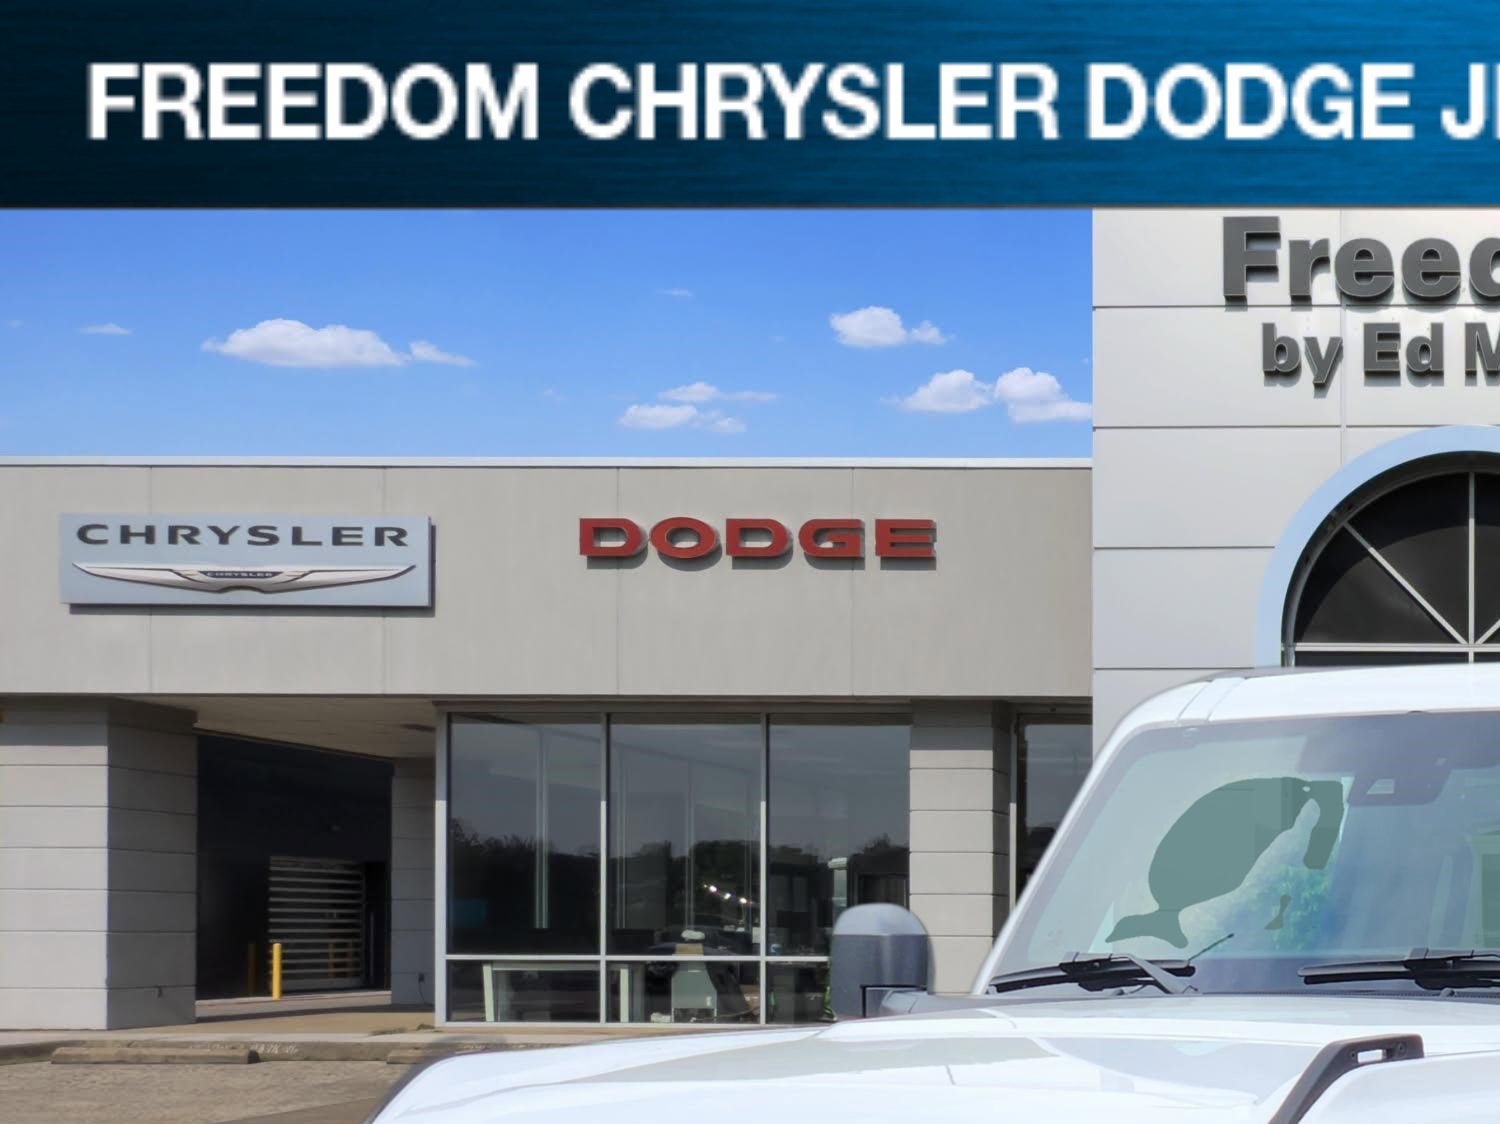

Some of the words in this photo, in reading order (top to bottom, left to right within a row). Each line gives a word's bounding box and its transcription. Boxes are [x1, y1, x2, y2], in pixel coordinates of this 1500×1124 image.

[1262, 322, 1343, 386] by
[1364, 322, 1445, 376] Ed
[76, 523, 408, 547] CHRYSLER
[579, 516, 936, 558] DODGE
